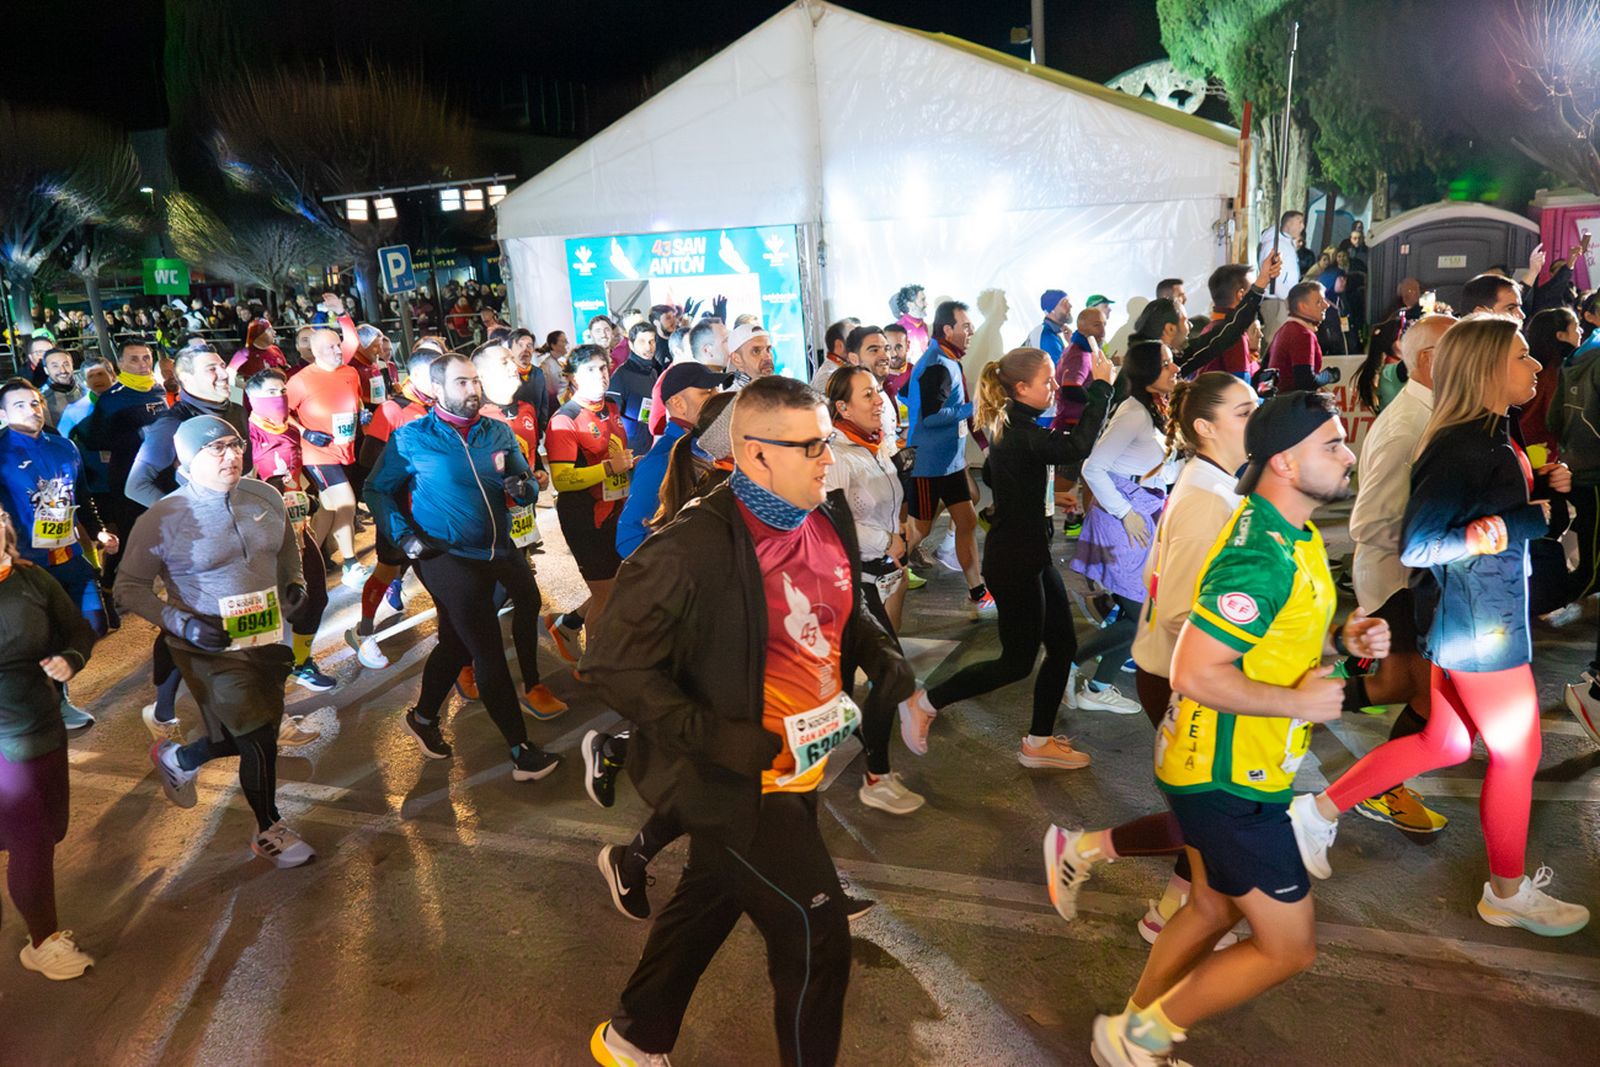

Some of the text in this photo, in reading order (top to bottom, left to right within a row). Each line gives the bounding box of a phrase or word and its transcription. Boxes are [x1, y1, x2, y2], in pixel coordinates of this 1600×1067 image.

[652, 236, 707, 257] 43 SAN
[154, 269, 179, 285] WC
[387, 252, 406, 288] P
[237, 609, 273, 633] 6941
[799, 733, 816, 745] SAN
